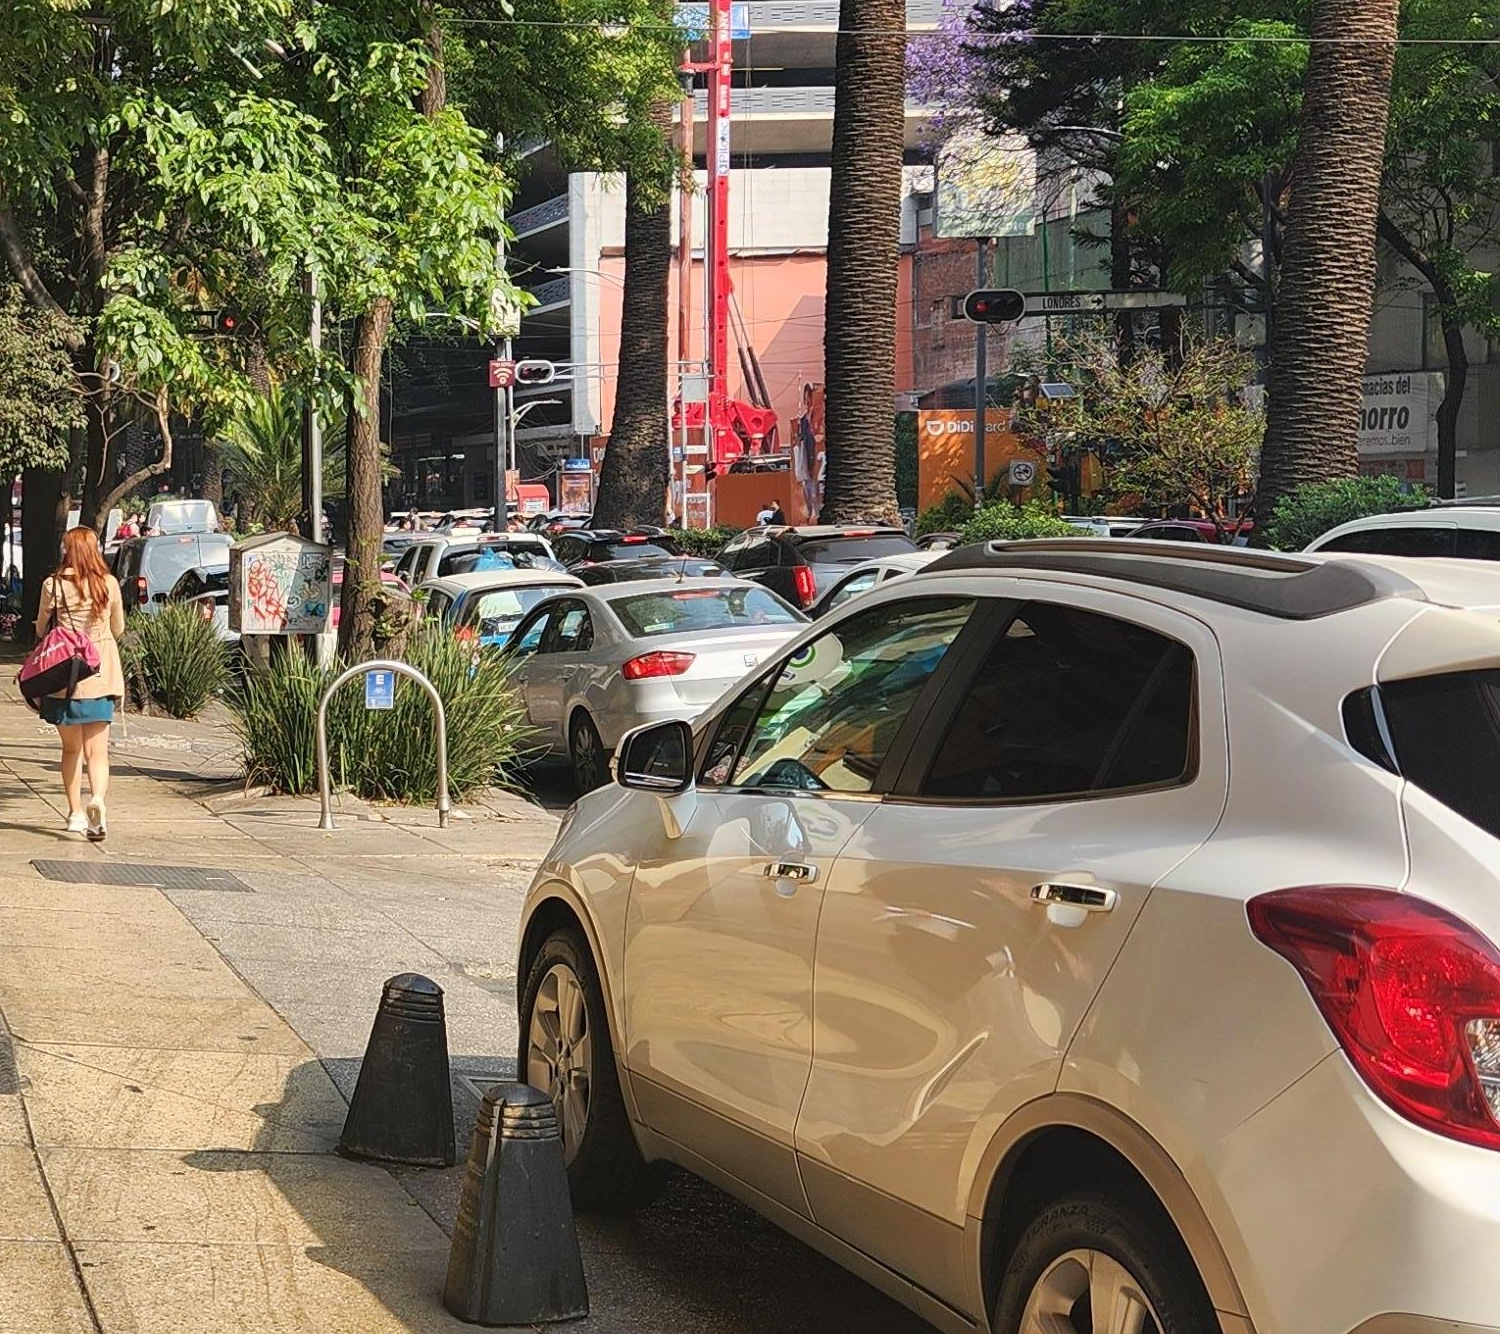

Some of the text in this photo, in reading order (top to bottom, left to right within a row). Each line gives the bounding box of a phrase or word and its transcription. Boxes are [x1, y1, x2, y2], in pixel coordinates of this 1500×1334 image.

[719, 121, 729, 161] Piloec
[1042, 297, 1081, 309] LONDRES
[1396, 376, 1410, 394] del
[947, 421, 1005, 433] DiDi ard
